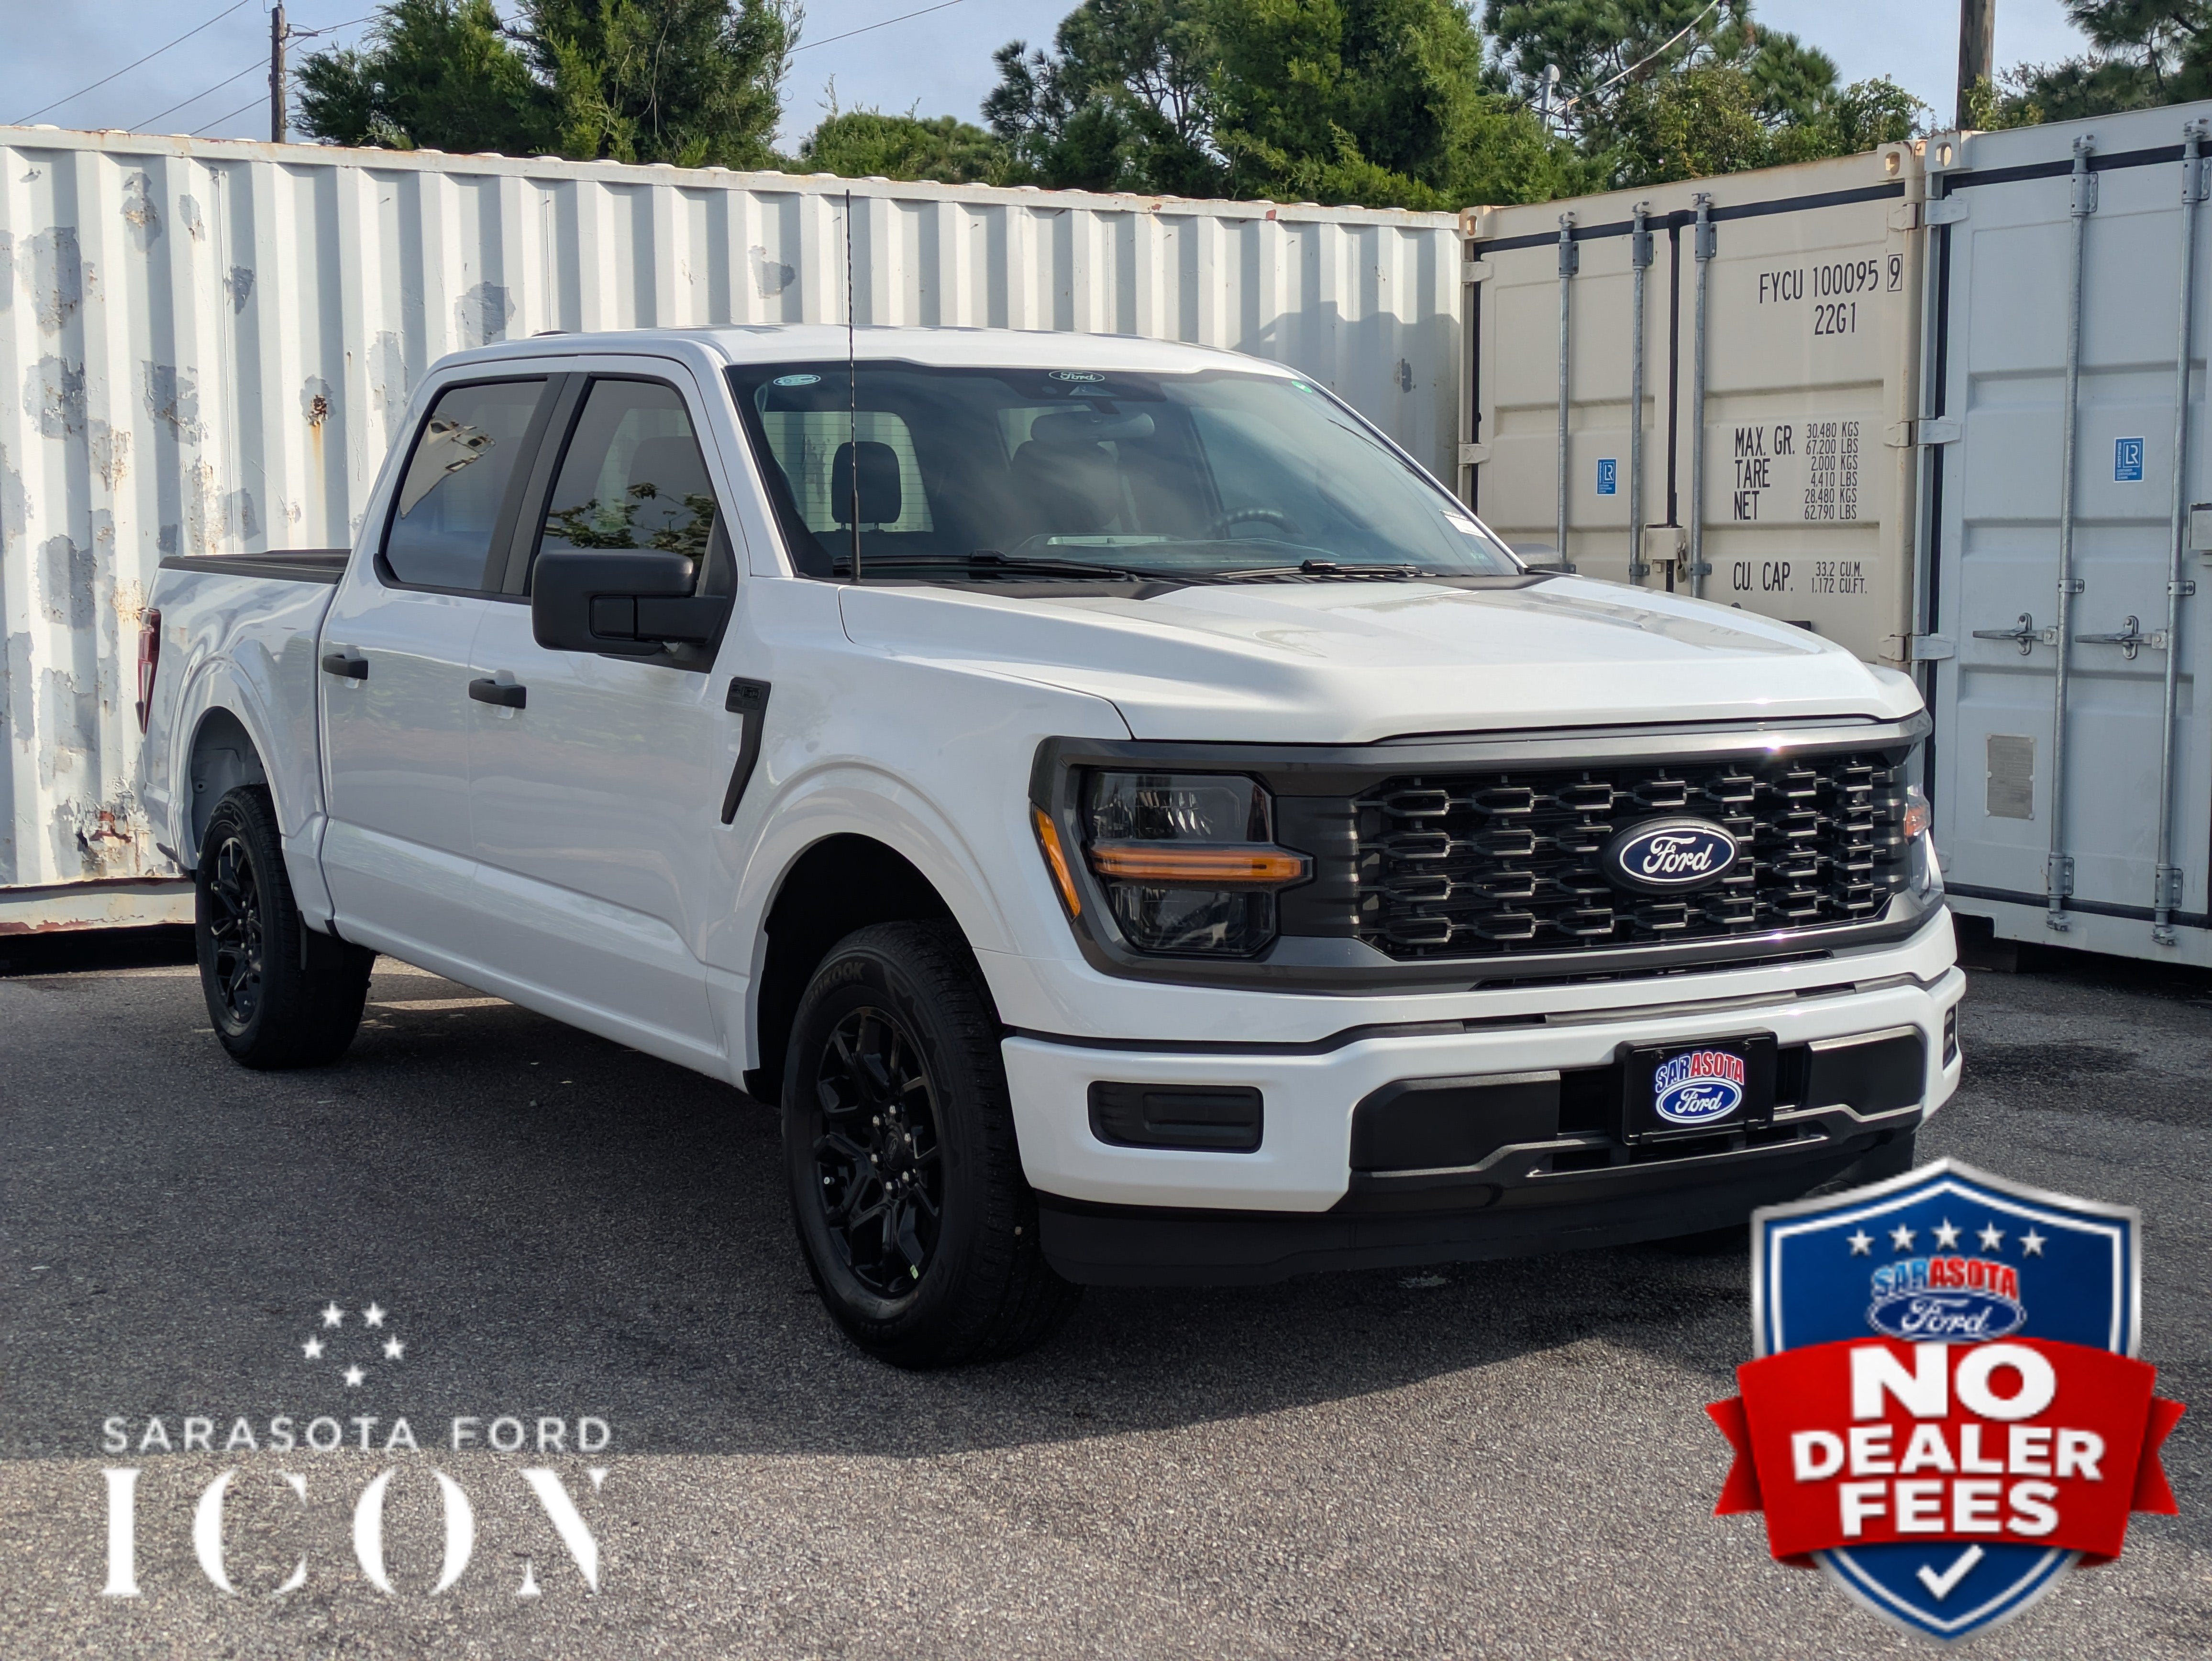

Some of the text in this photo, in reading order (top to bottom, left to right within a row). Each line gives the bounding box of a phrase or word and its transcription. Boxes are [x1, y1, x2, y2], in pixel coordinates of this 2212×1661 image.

[1759, 257, 1901, 304] FYCU 100095 9
[1814, 302, 1856, 335] 22G1
[1060, 371, 1095, 381] Ford
[1735, 426, 1766, 457] MAX.
[1774, 425, 1795, 455] GR.
[1842, 421, 1859, 437] KGS
[1841, 438, 1858, 454] LBS
[1735, 458, 1770, 488] TARE
[1840, 454, 1858, 470] KGS
[1840, 471, 1858, 487] LBS
[1734, 490, 1760, 520] NET
[1839, 487, 1857, 503] KGS
[1839, 504, 1857, 520] LBS
[1733, 561, 1863, 591] CU. CAP. 33.2 CU.M.
[1839, 577, 1868, 594] CU.FT.
[1643, 836, 1714, 874] Ford
[1655, 1051, 1745, 1094] SARASOTA
[1675, 1087, 1724, 1114] Ford
